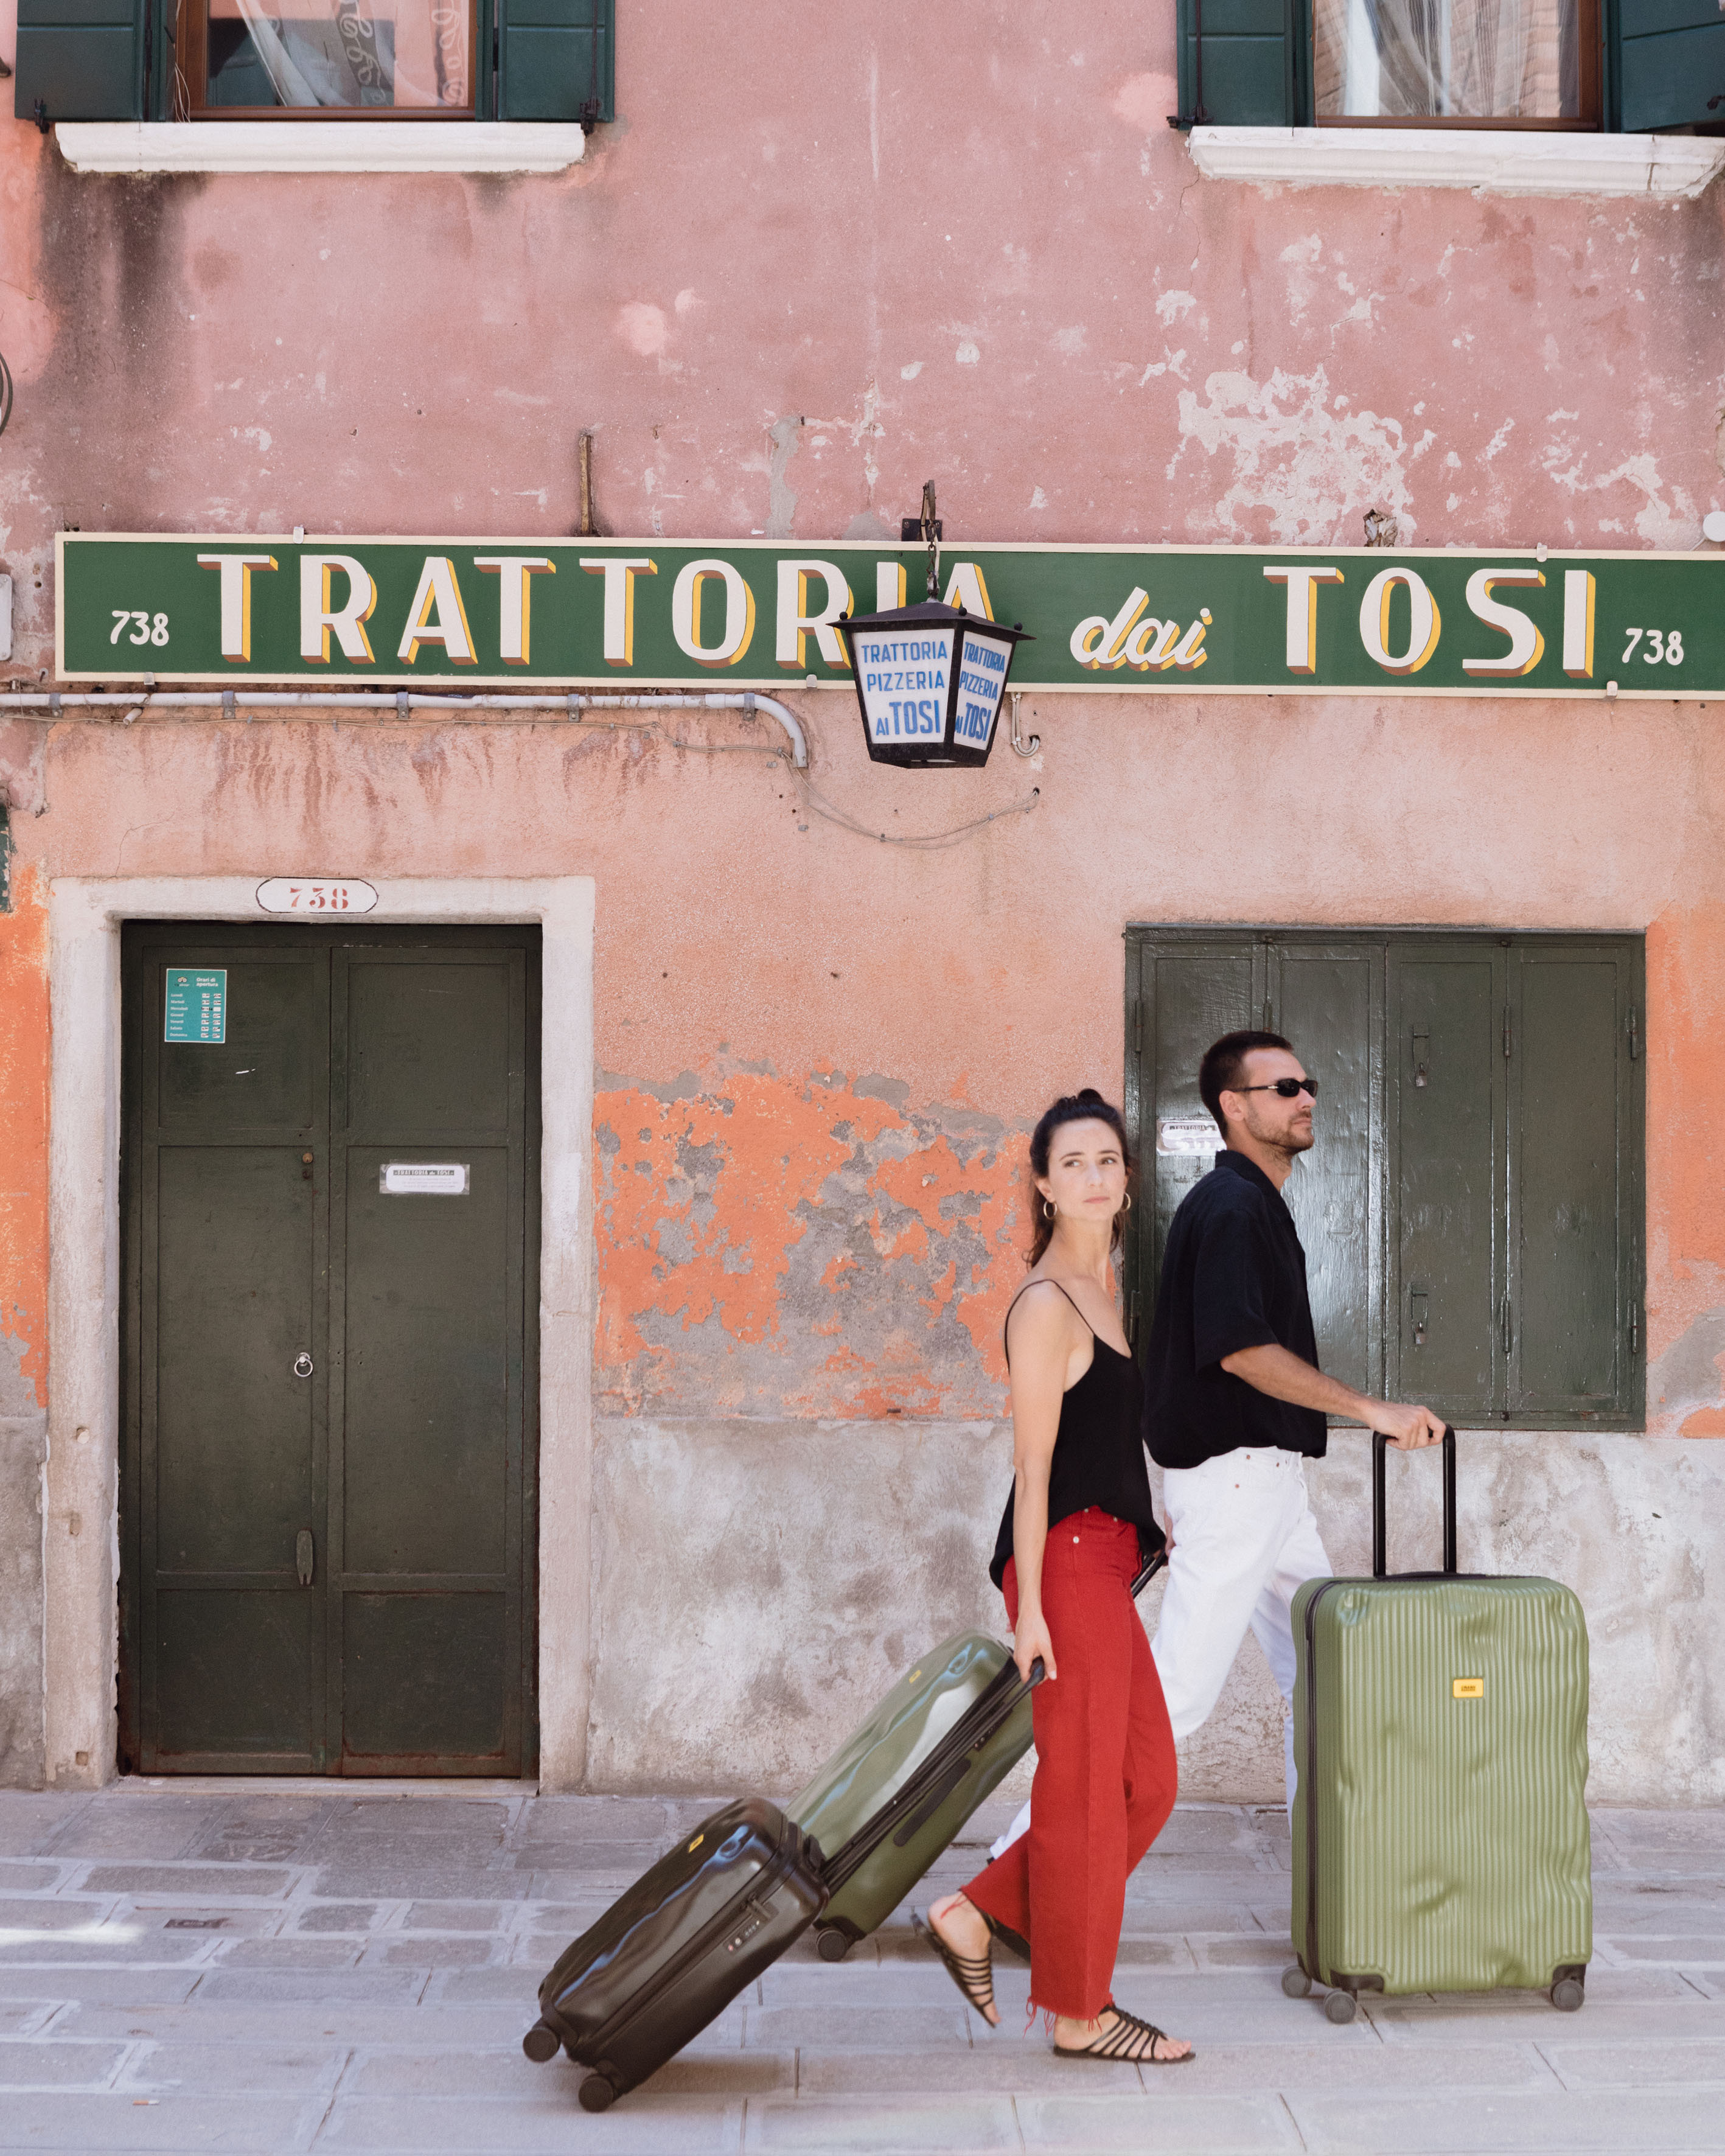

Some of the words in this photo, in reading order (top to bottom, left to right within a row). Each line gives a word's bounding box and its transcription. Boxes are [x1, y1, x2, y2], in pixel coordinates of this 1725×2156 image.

[110, 610, 170, 647] 738
[1069, 586, 1213, 671] dai
[1263, 565, 1597, 679] TOSI
[1620, 627, 1684, 666] 738
[861, 641, 947, 663] TRATTORIA
[964, 641, 1006, 673] TRATTORIA
[866, 670, 946, 692] PIZZERIA
[959, 671, 998, 701] PIZZERIA
[889, 700, 941, 735] TOSI
[963, 702, 992, 742] TOSI
[290, 887, 349, 910] 738
